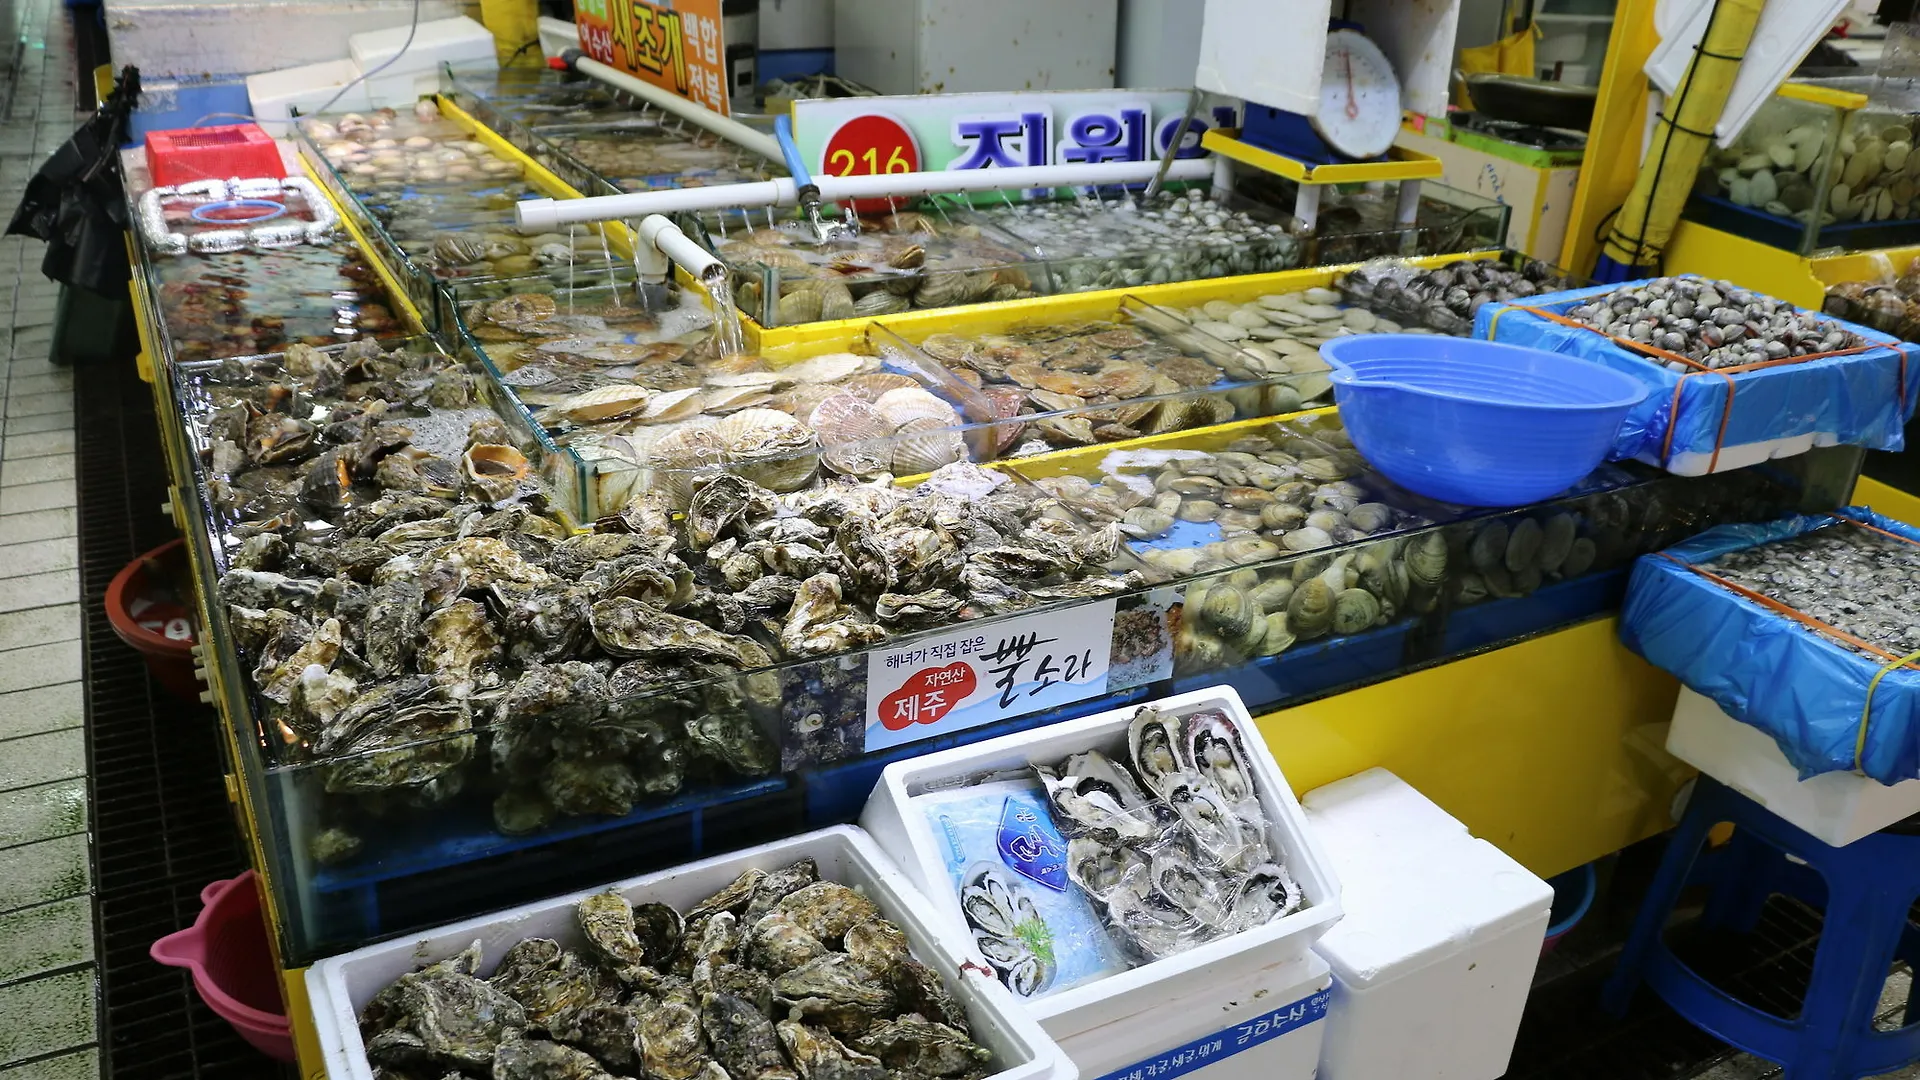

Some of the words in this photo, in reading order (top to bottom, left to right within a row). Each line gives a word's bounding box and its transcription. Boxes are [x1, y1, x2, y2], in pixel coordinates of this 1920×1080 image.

[611, 0, 689, 95] 새조개
[682, 12, 718, 65] 백합
[688, 64, 722, 113] 전복
[830, 146, 910, 177] 216
[886, 648, 927, 669] 해녀가
[930, 642, 958, 662] 직접
[959, 635, 986, 655] 잡은
[925, 667, 966, 687] 자연산
[893, 689, 947, 721] 제주
